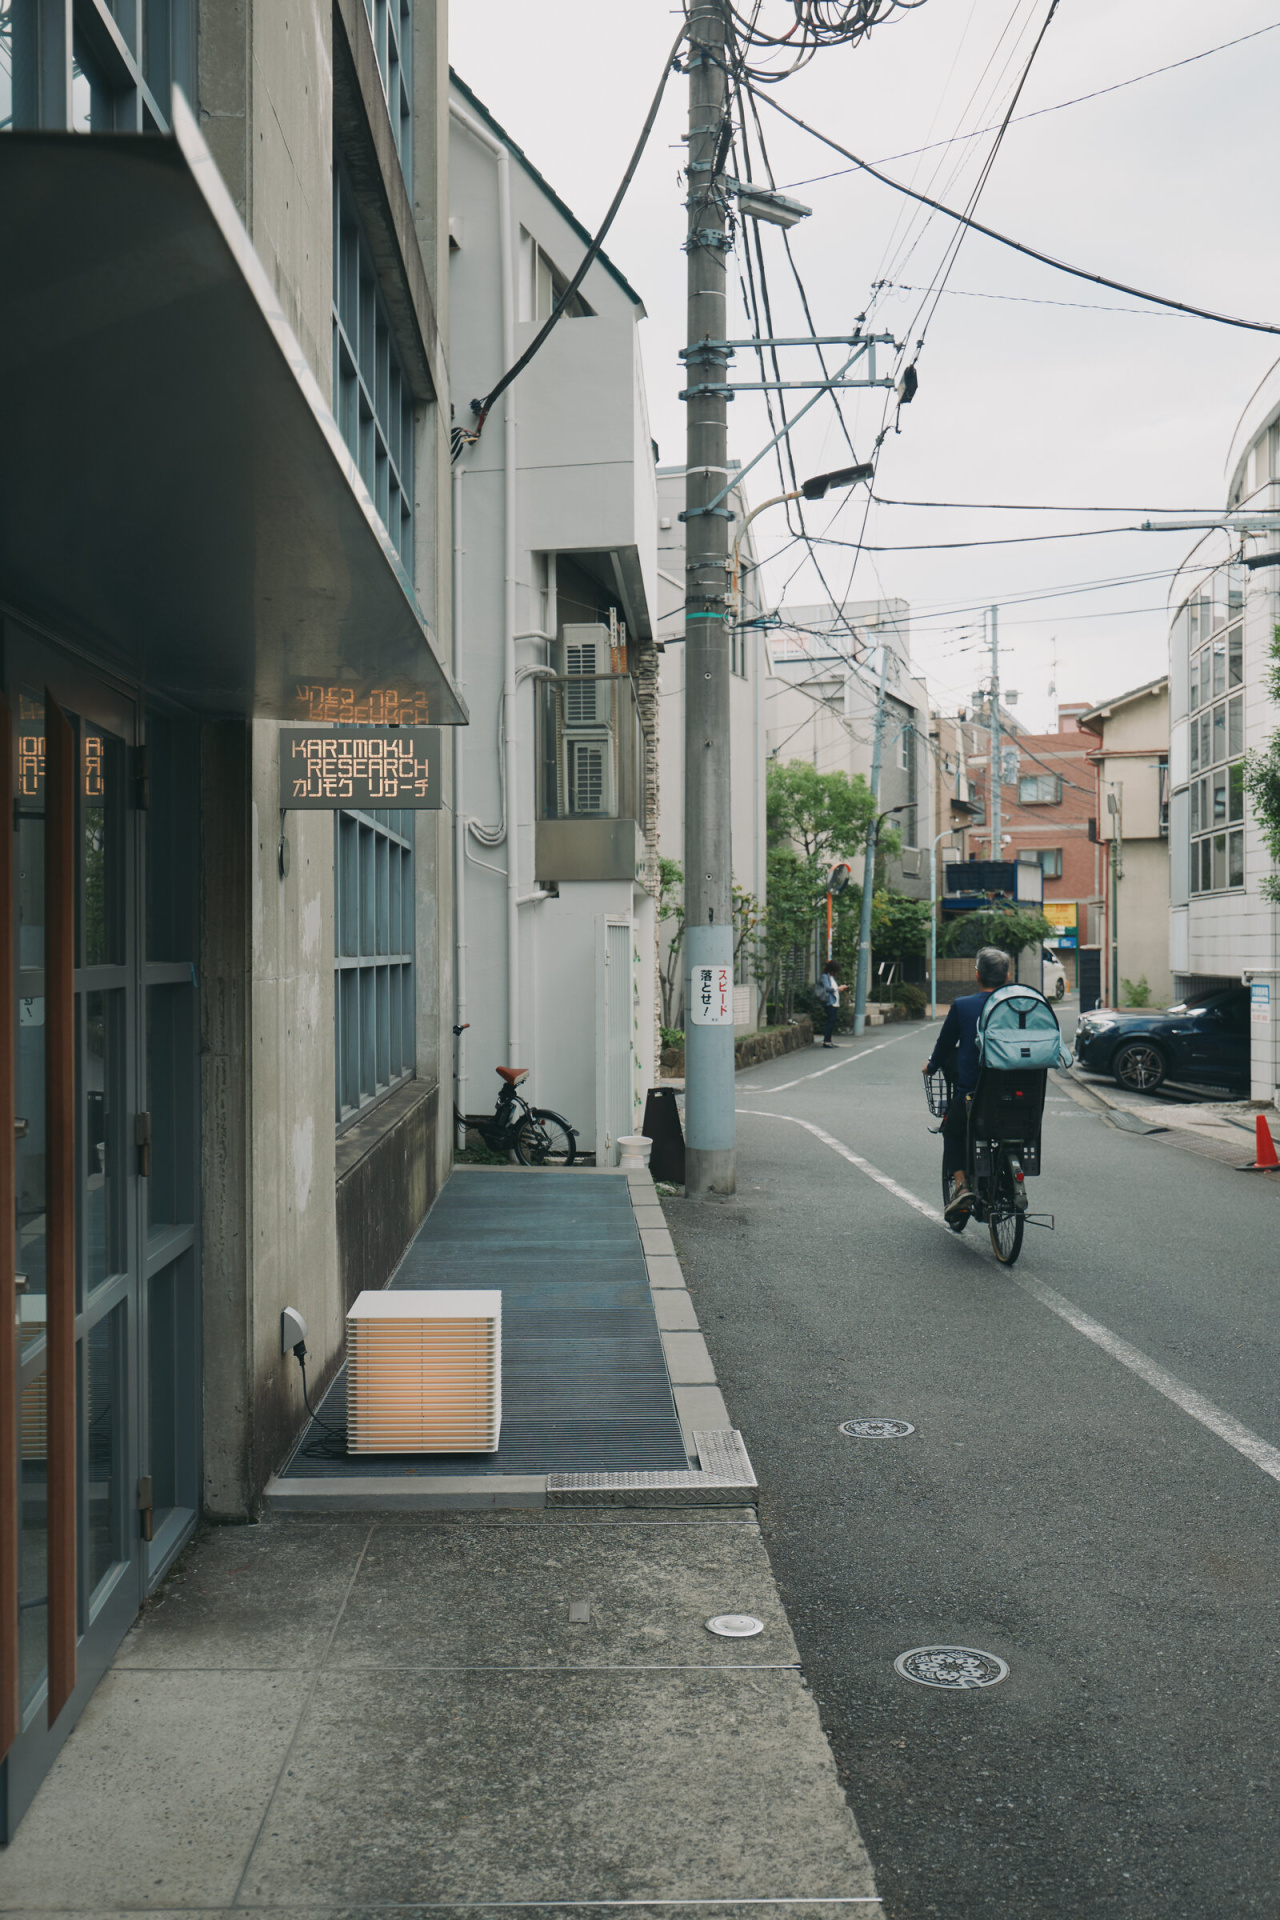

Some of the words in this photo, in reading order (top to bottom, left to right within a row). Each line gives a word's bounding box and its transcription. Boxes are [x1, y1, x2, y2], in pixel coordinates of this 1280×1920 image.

[292, 739, 414, 758] KARIMOKU
[307, 758, 429, 778] RESEARCH
[292, 778, 353, 797] カリモク
[368, 778, 429, 797] リサーチ
[718, 969, 728, 1017] スピード
